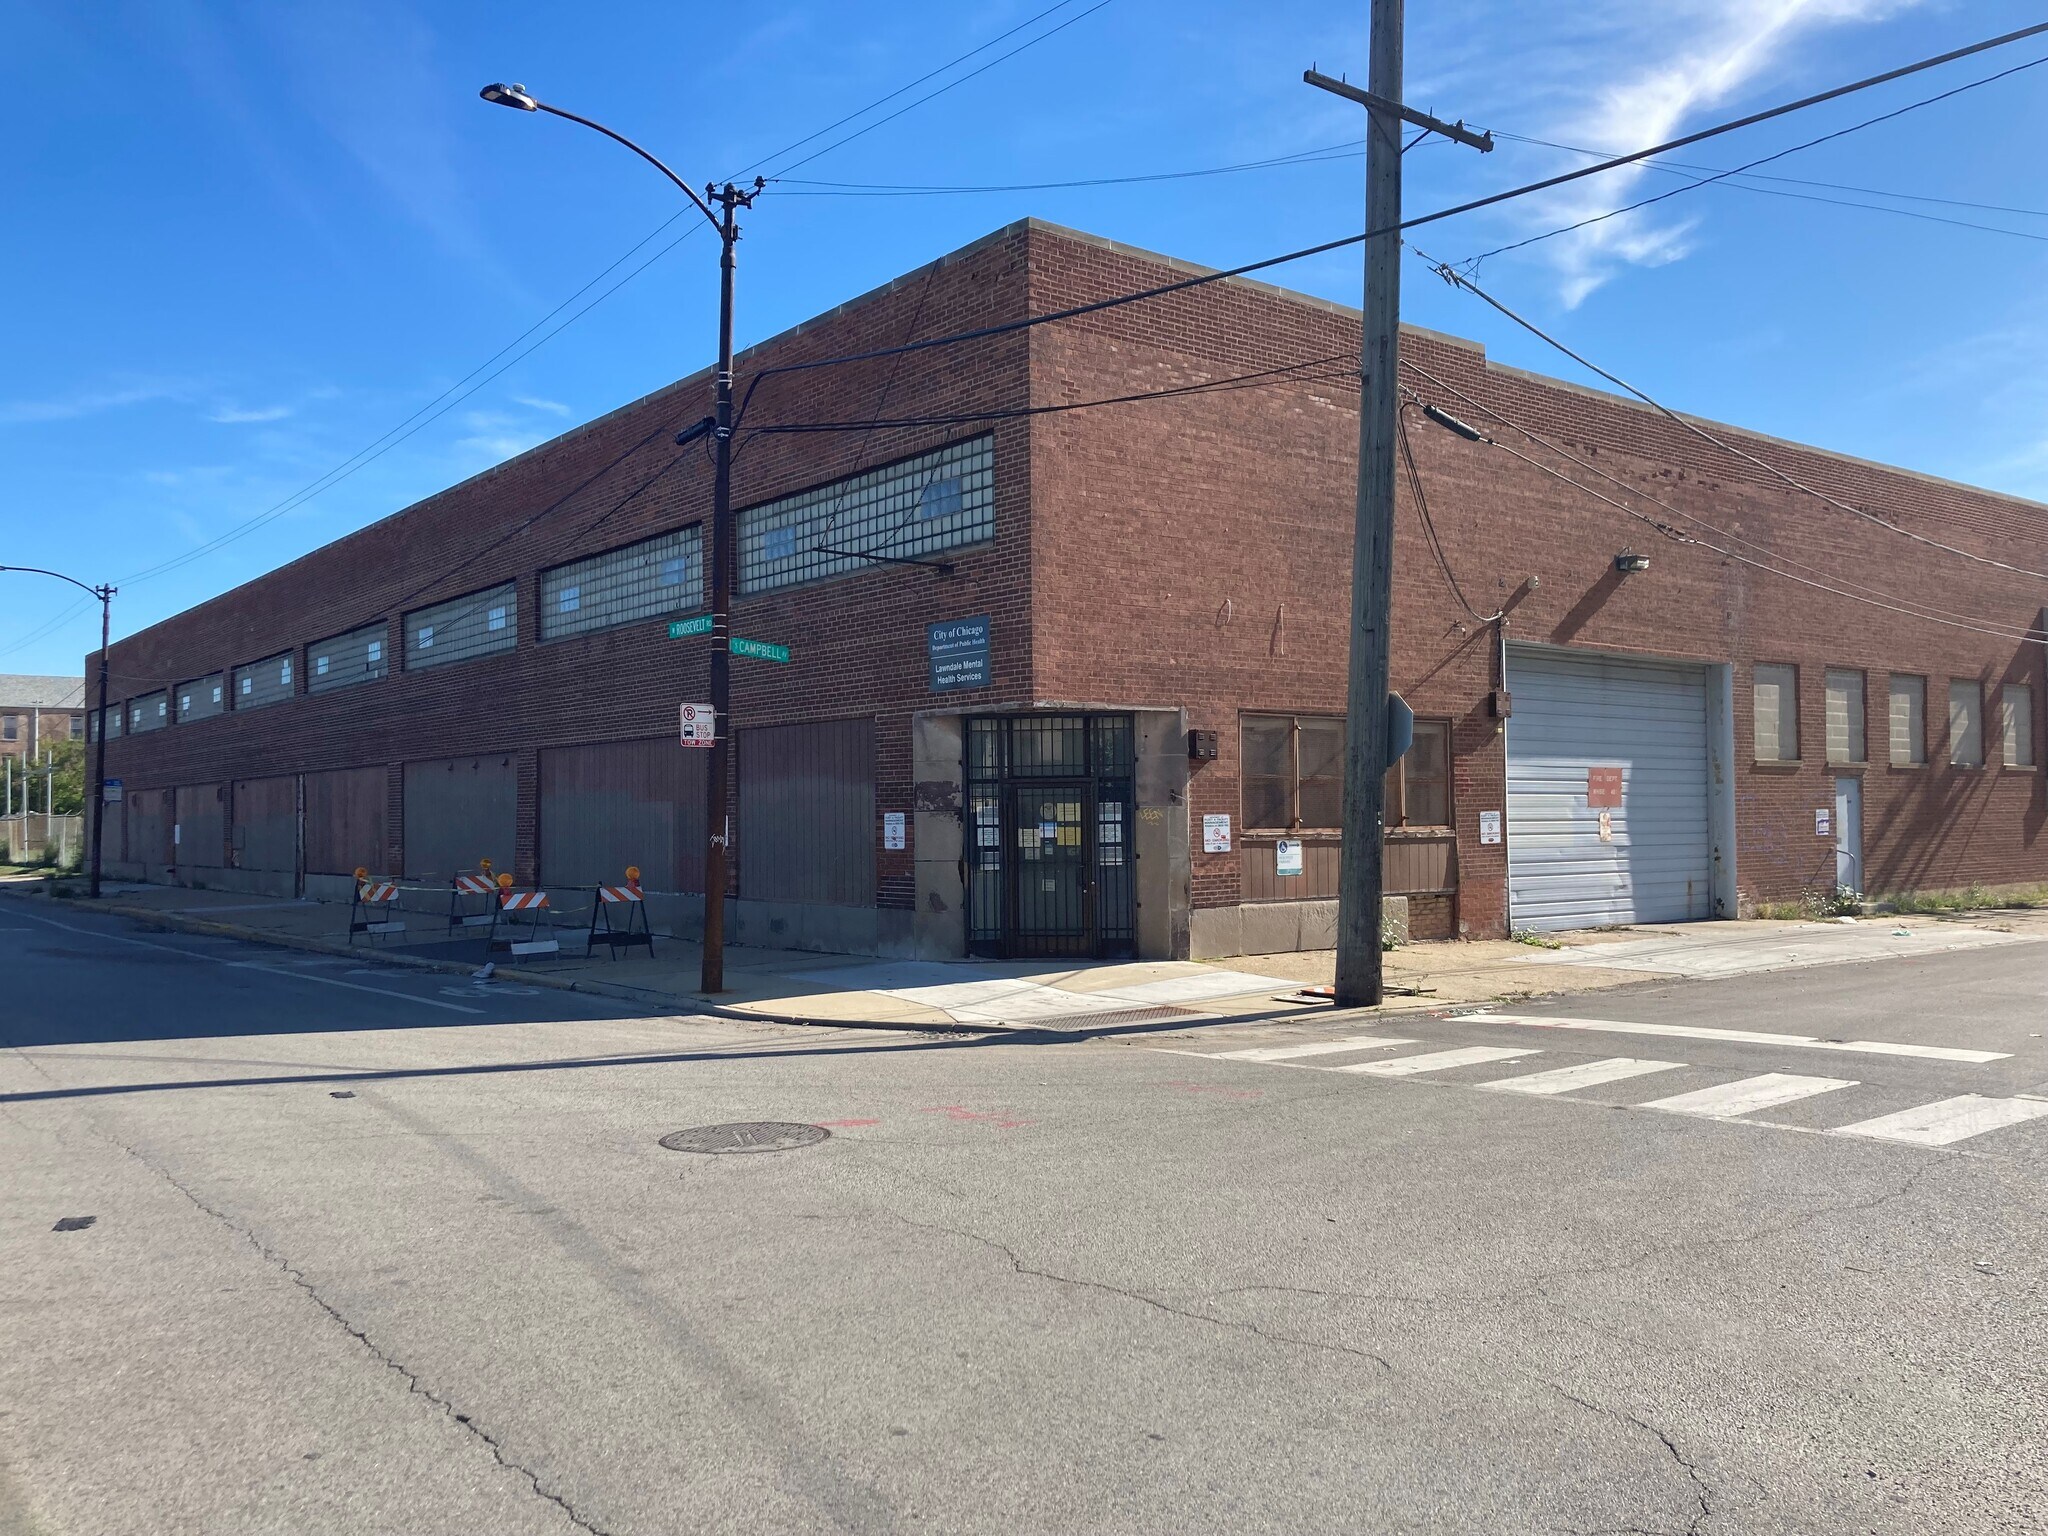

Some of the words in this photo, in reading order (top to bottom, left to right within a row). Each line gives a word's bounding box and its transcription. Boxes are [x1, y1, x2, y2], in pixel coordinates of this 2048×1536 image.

[676, 618, 706, 635] ROOSEVELT
[933, 630, 947, 641] City
[948, 628, 956, 638] of
[956, 625, 983, 636] Chicago
[739, 641, 782, 659] CAMPBELL
[932, 643, 954, 651] Department
[959, 639, 972, 647] Public
[971, 638, 985, 646] Health
[935, 662, 962, 673] Lawndale
[963, 659, 983, 669] Mental
[937, 674, 956, 684] Health
[956, 672, 982, 682] Services
